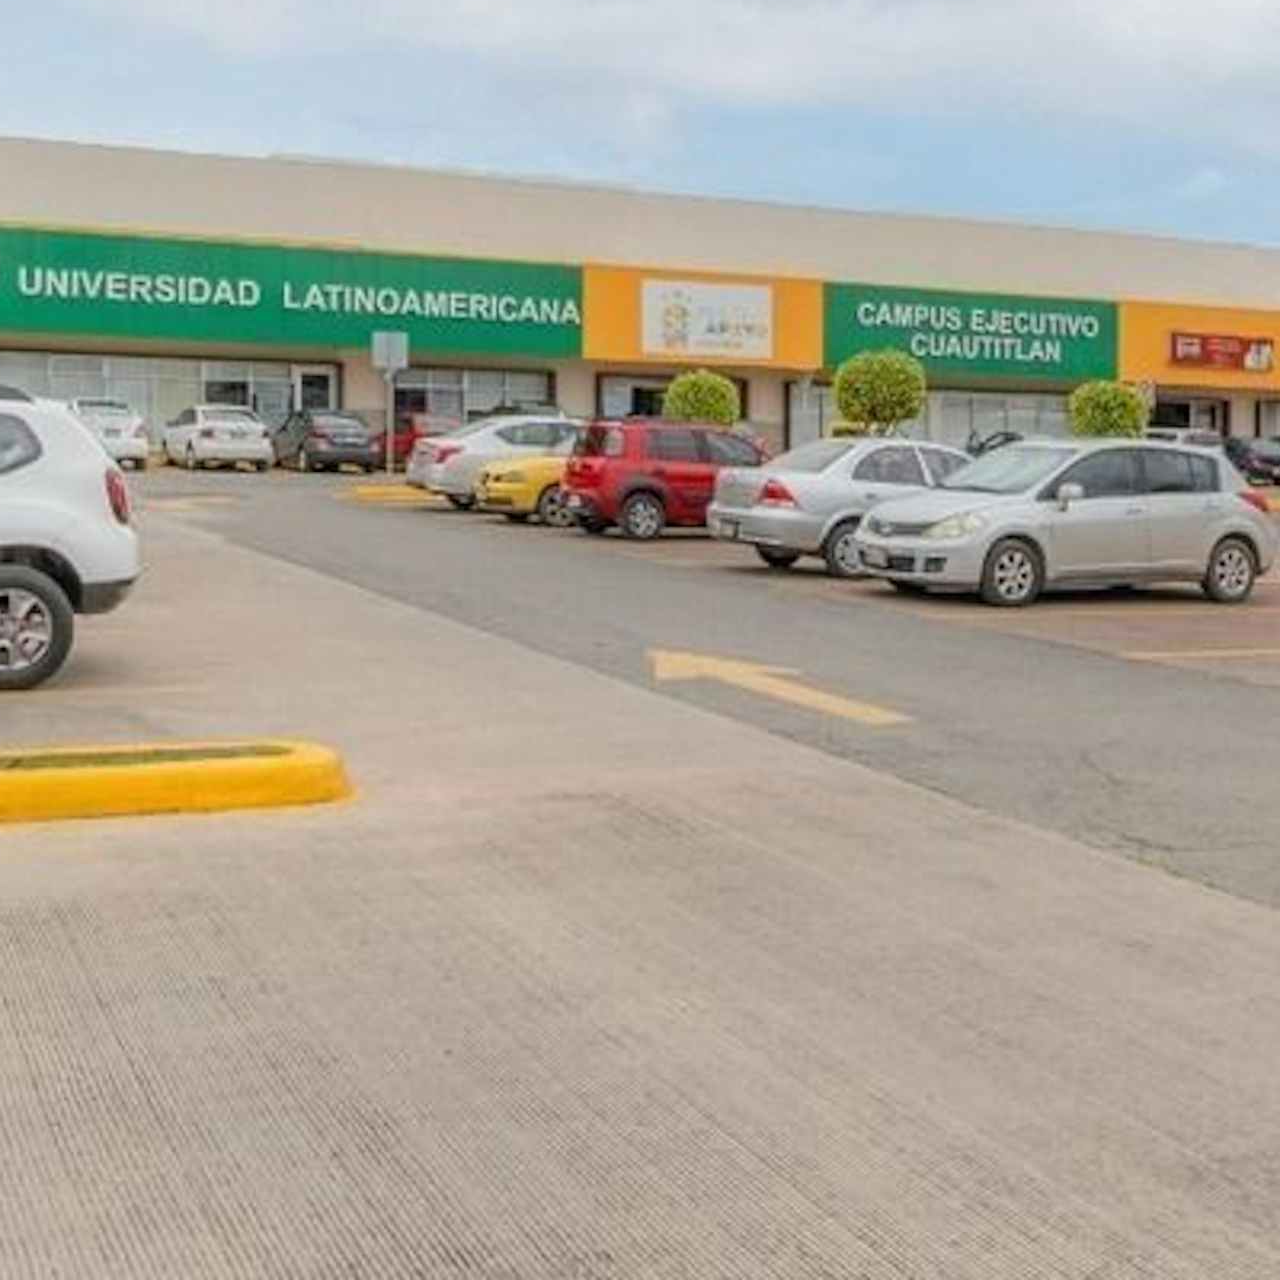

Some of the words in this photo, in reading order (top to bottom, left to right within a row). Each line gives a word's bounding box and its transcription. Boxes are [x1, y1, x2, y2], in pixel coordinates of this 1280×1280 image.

[17, 266, 260, 307] UNIVERSIDAD
[283, 281, 581, 325] LATINOAMERICANA
[856, 302, 962, 331] CAMPUS
[970, 309, 1099, 337] EJECUTIVO
[910, 334, 1061, 362] CUAUTITLAN
